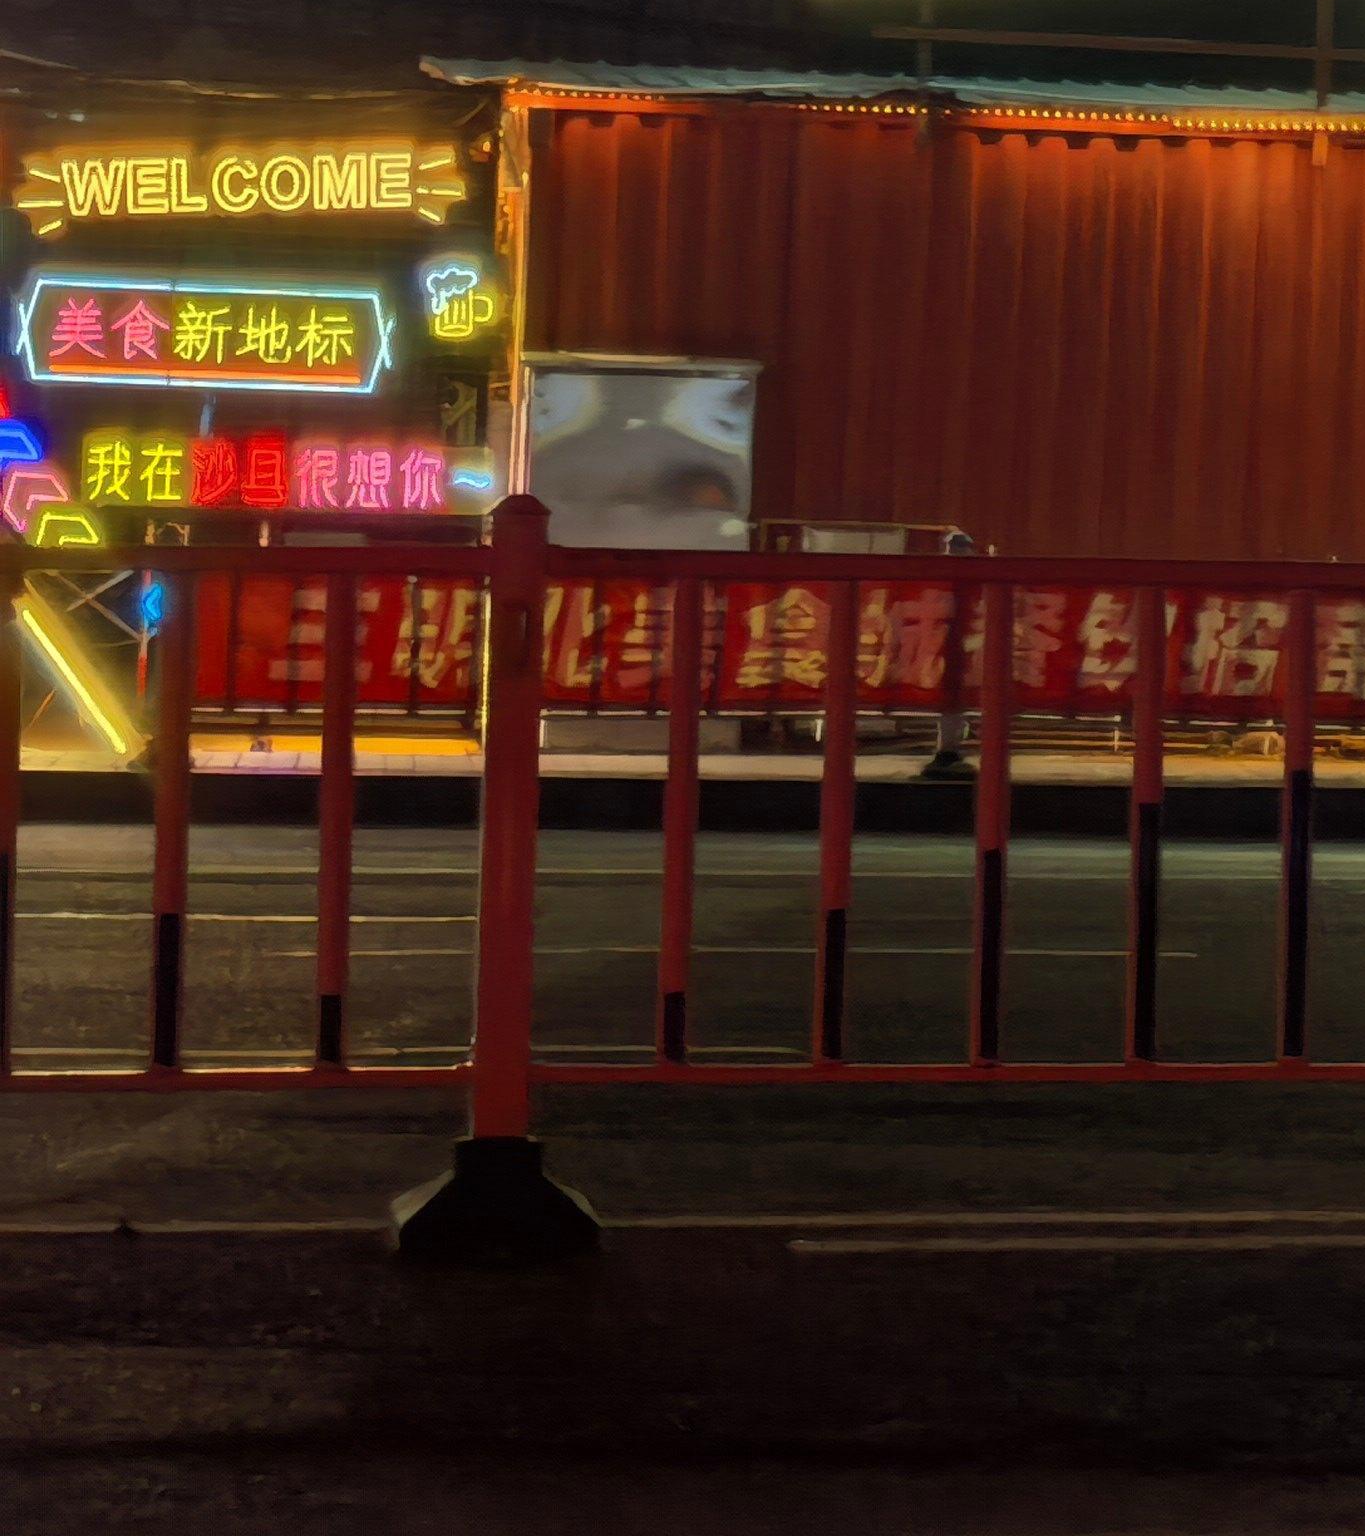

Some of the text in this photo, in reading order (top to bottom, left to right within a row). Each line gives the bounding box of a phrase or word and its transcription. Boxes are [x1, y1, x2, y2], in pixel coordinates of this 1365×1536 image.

[60, 152, 413, 216] WELCOME
[48, 298, 356, 369] 美食新地标
